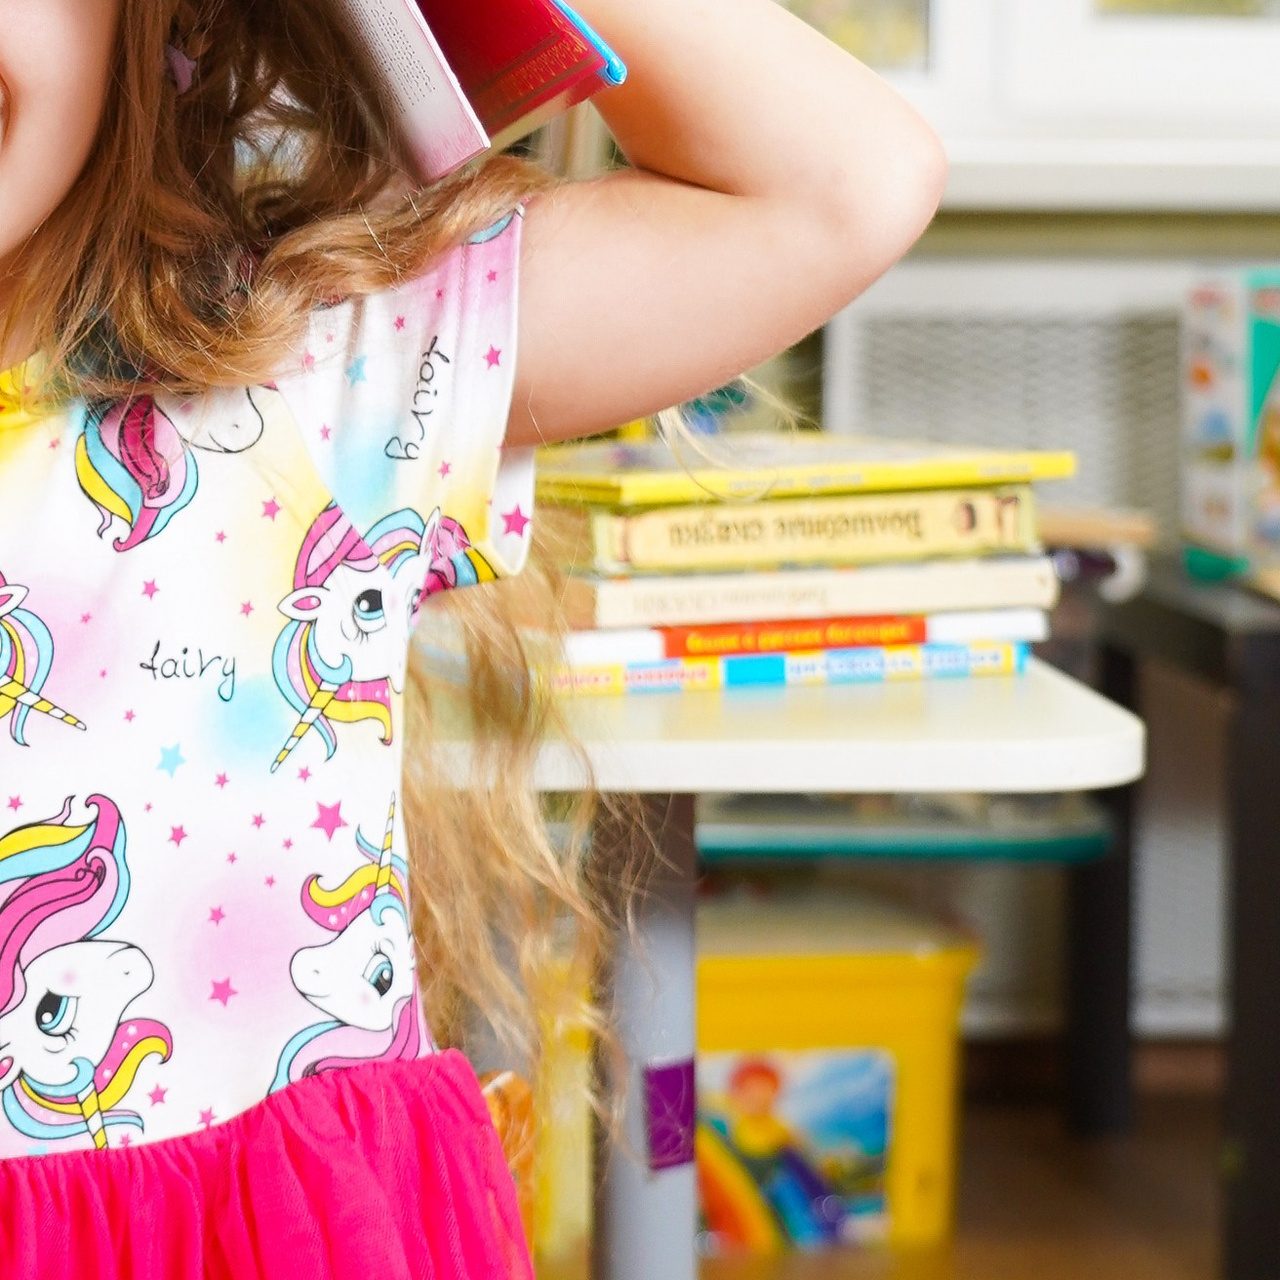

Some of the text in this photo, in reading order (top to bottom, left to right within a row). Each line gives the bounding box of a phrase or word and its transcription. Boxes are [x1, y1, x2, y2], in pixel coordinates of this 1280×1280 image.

[384, 335, 450, 460] fairy
[668, 509, 925, 548] Волшебные сказки
[139, 642, 236, 701] fairy
